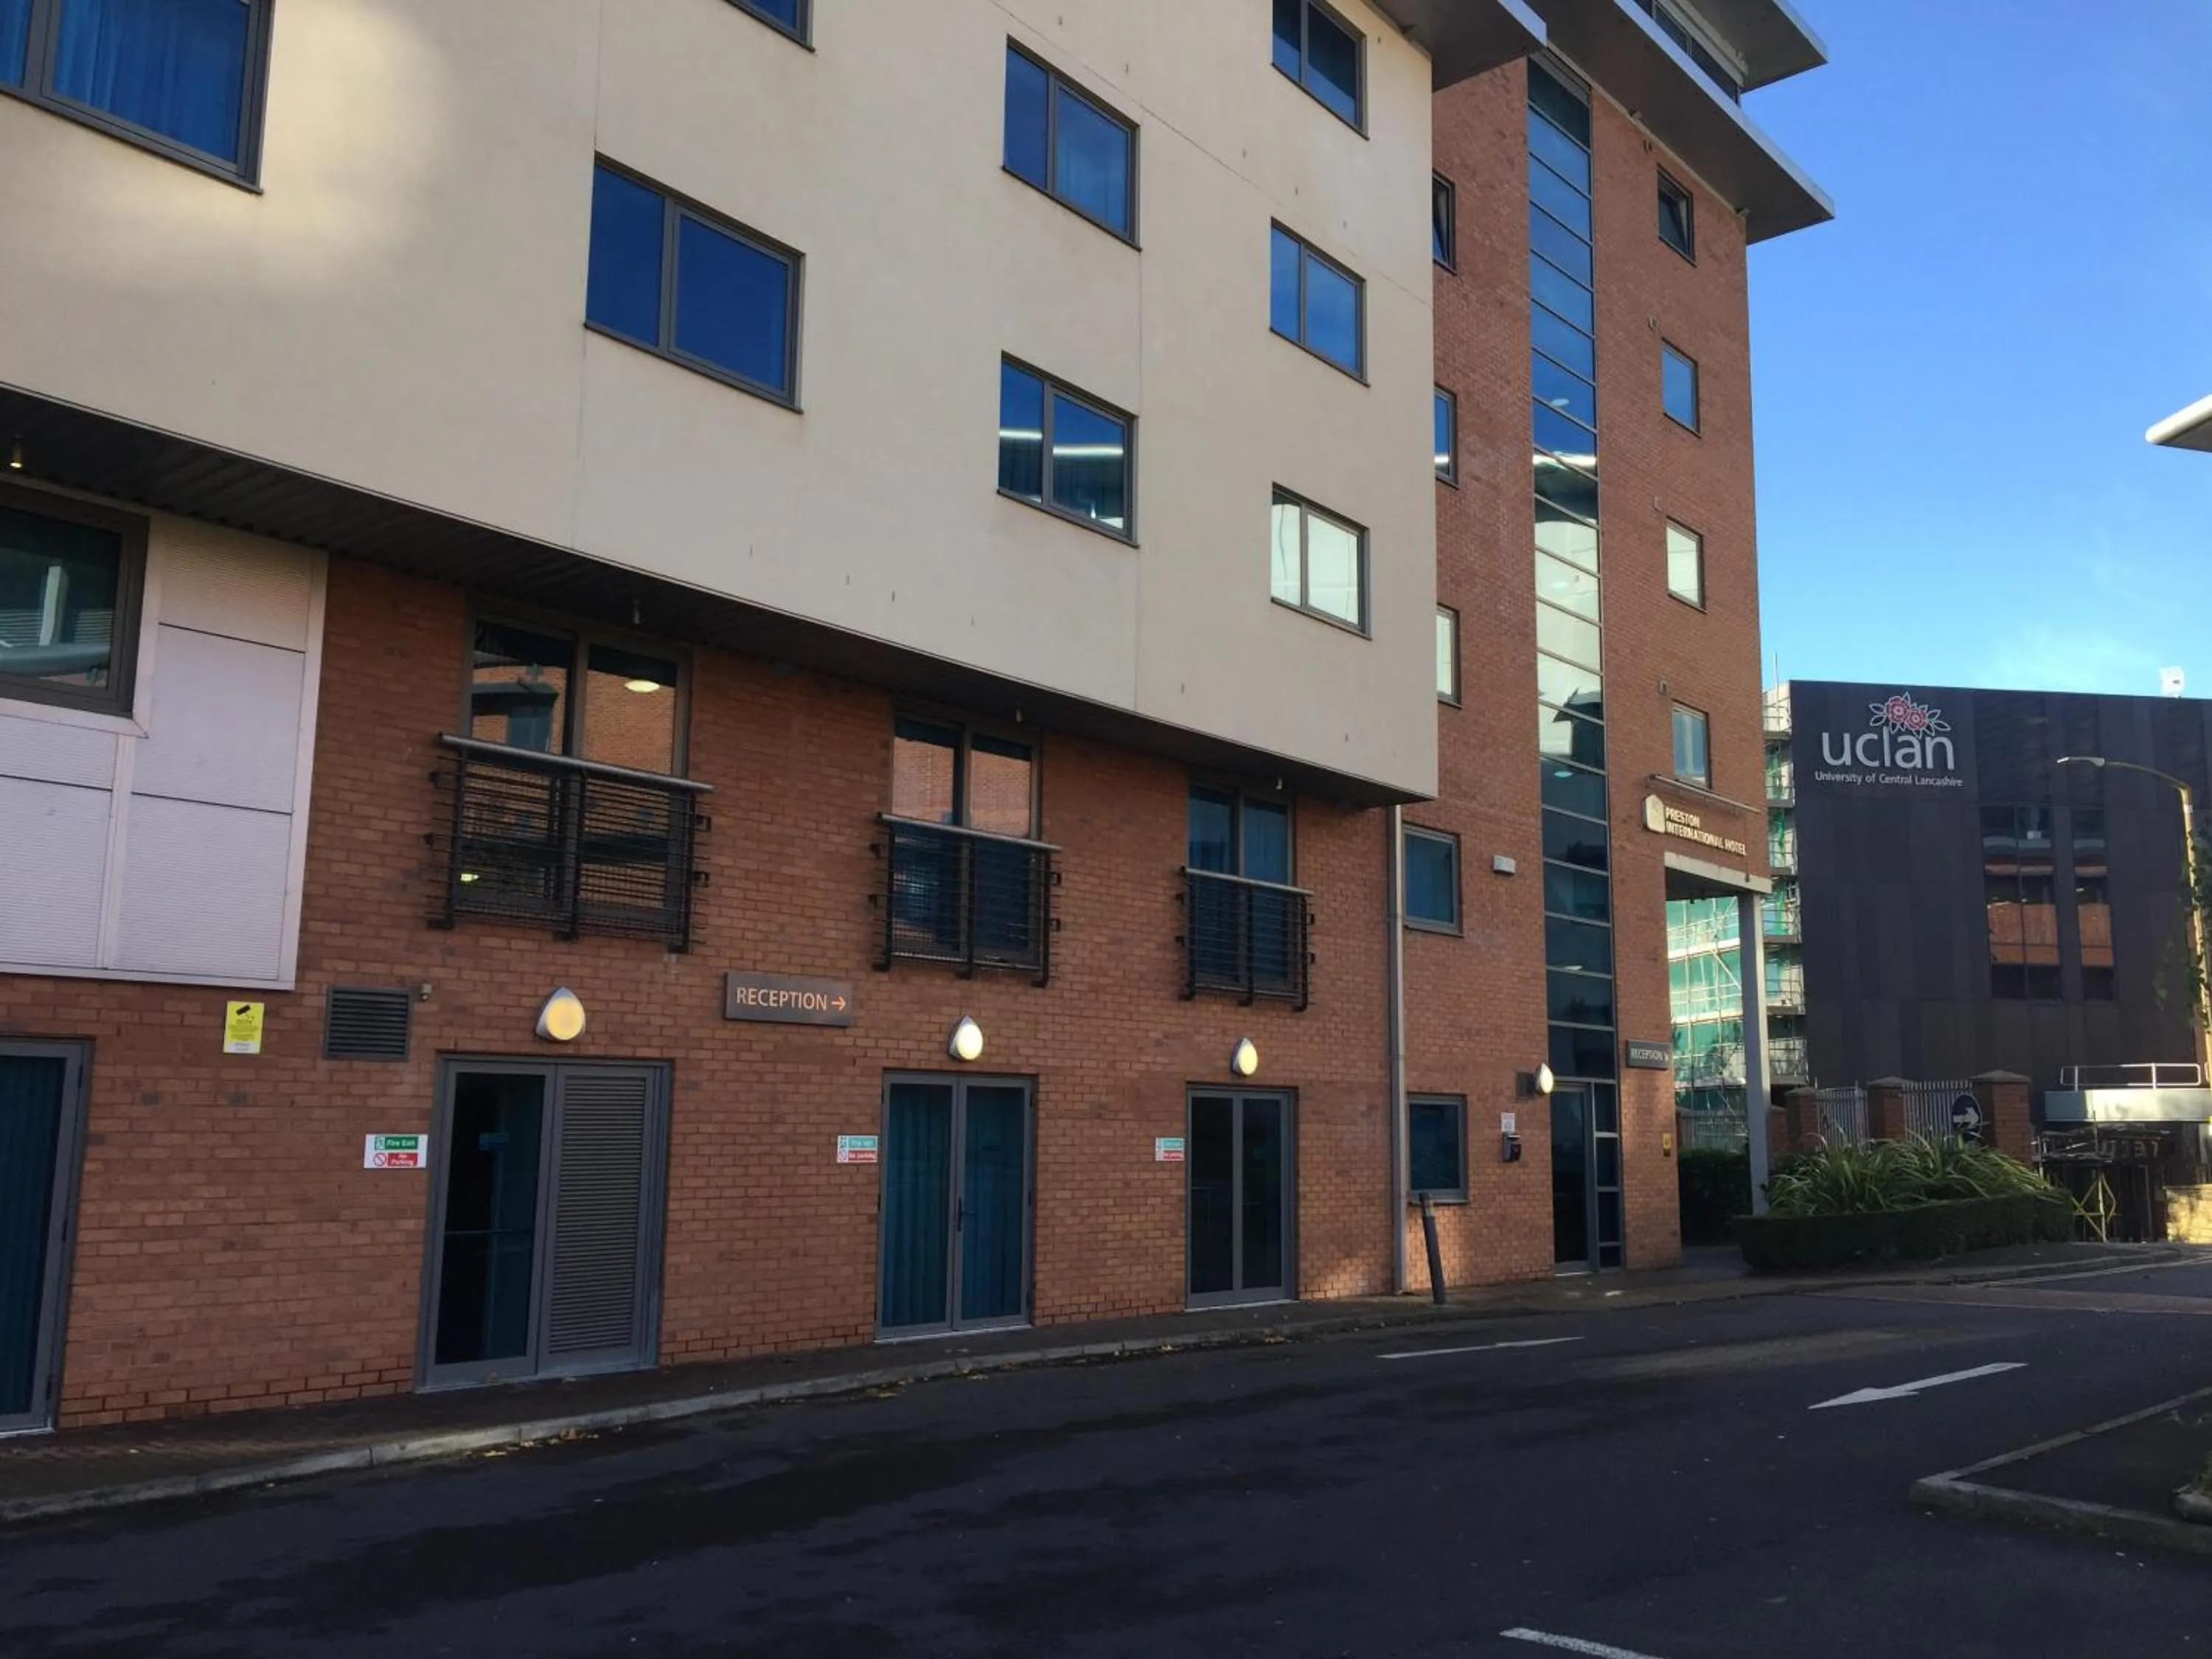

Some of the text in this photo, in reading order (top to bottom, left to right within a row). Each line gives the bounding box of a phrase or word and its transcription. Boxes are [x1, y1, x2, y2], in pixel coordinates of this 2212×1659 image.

[1822, 726, 1955, 770] uclan
[1815, 771, 1964, 787] University of Central Lancashire
[1666, 807, 1700, 829] PRESTON
[1666, 820, 1747, 856] INTERNATIONAL HOTEL
[737, 987, 827, 1011] RECEPTION
[1630, 1048, 1663, 1061] RECEPTION
